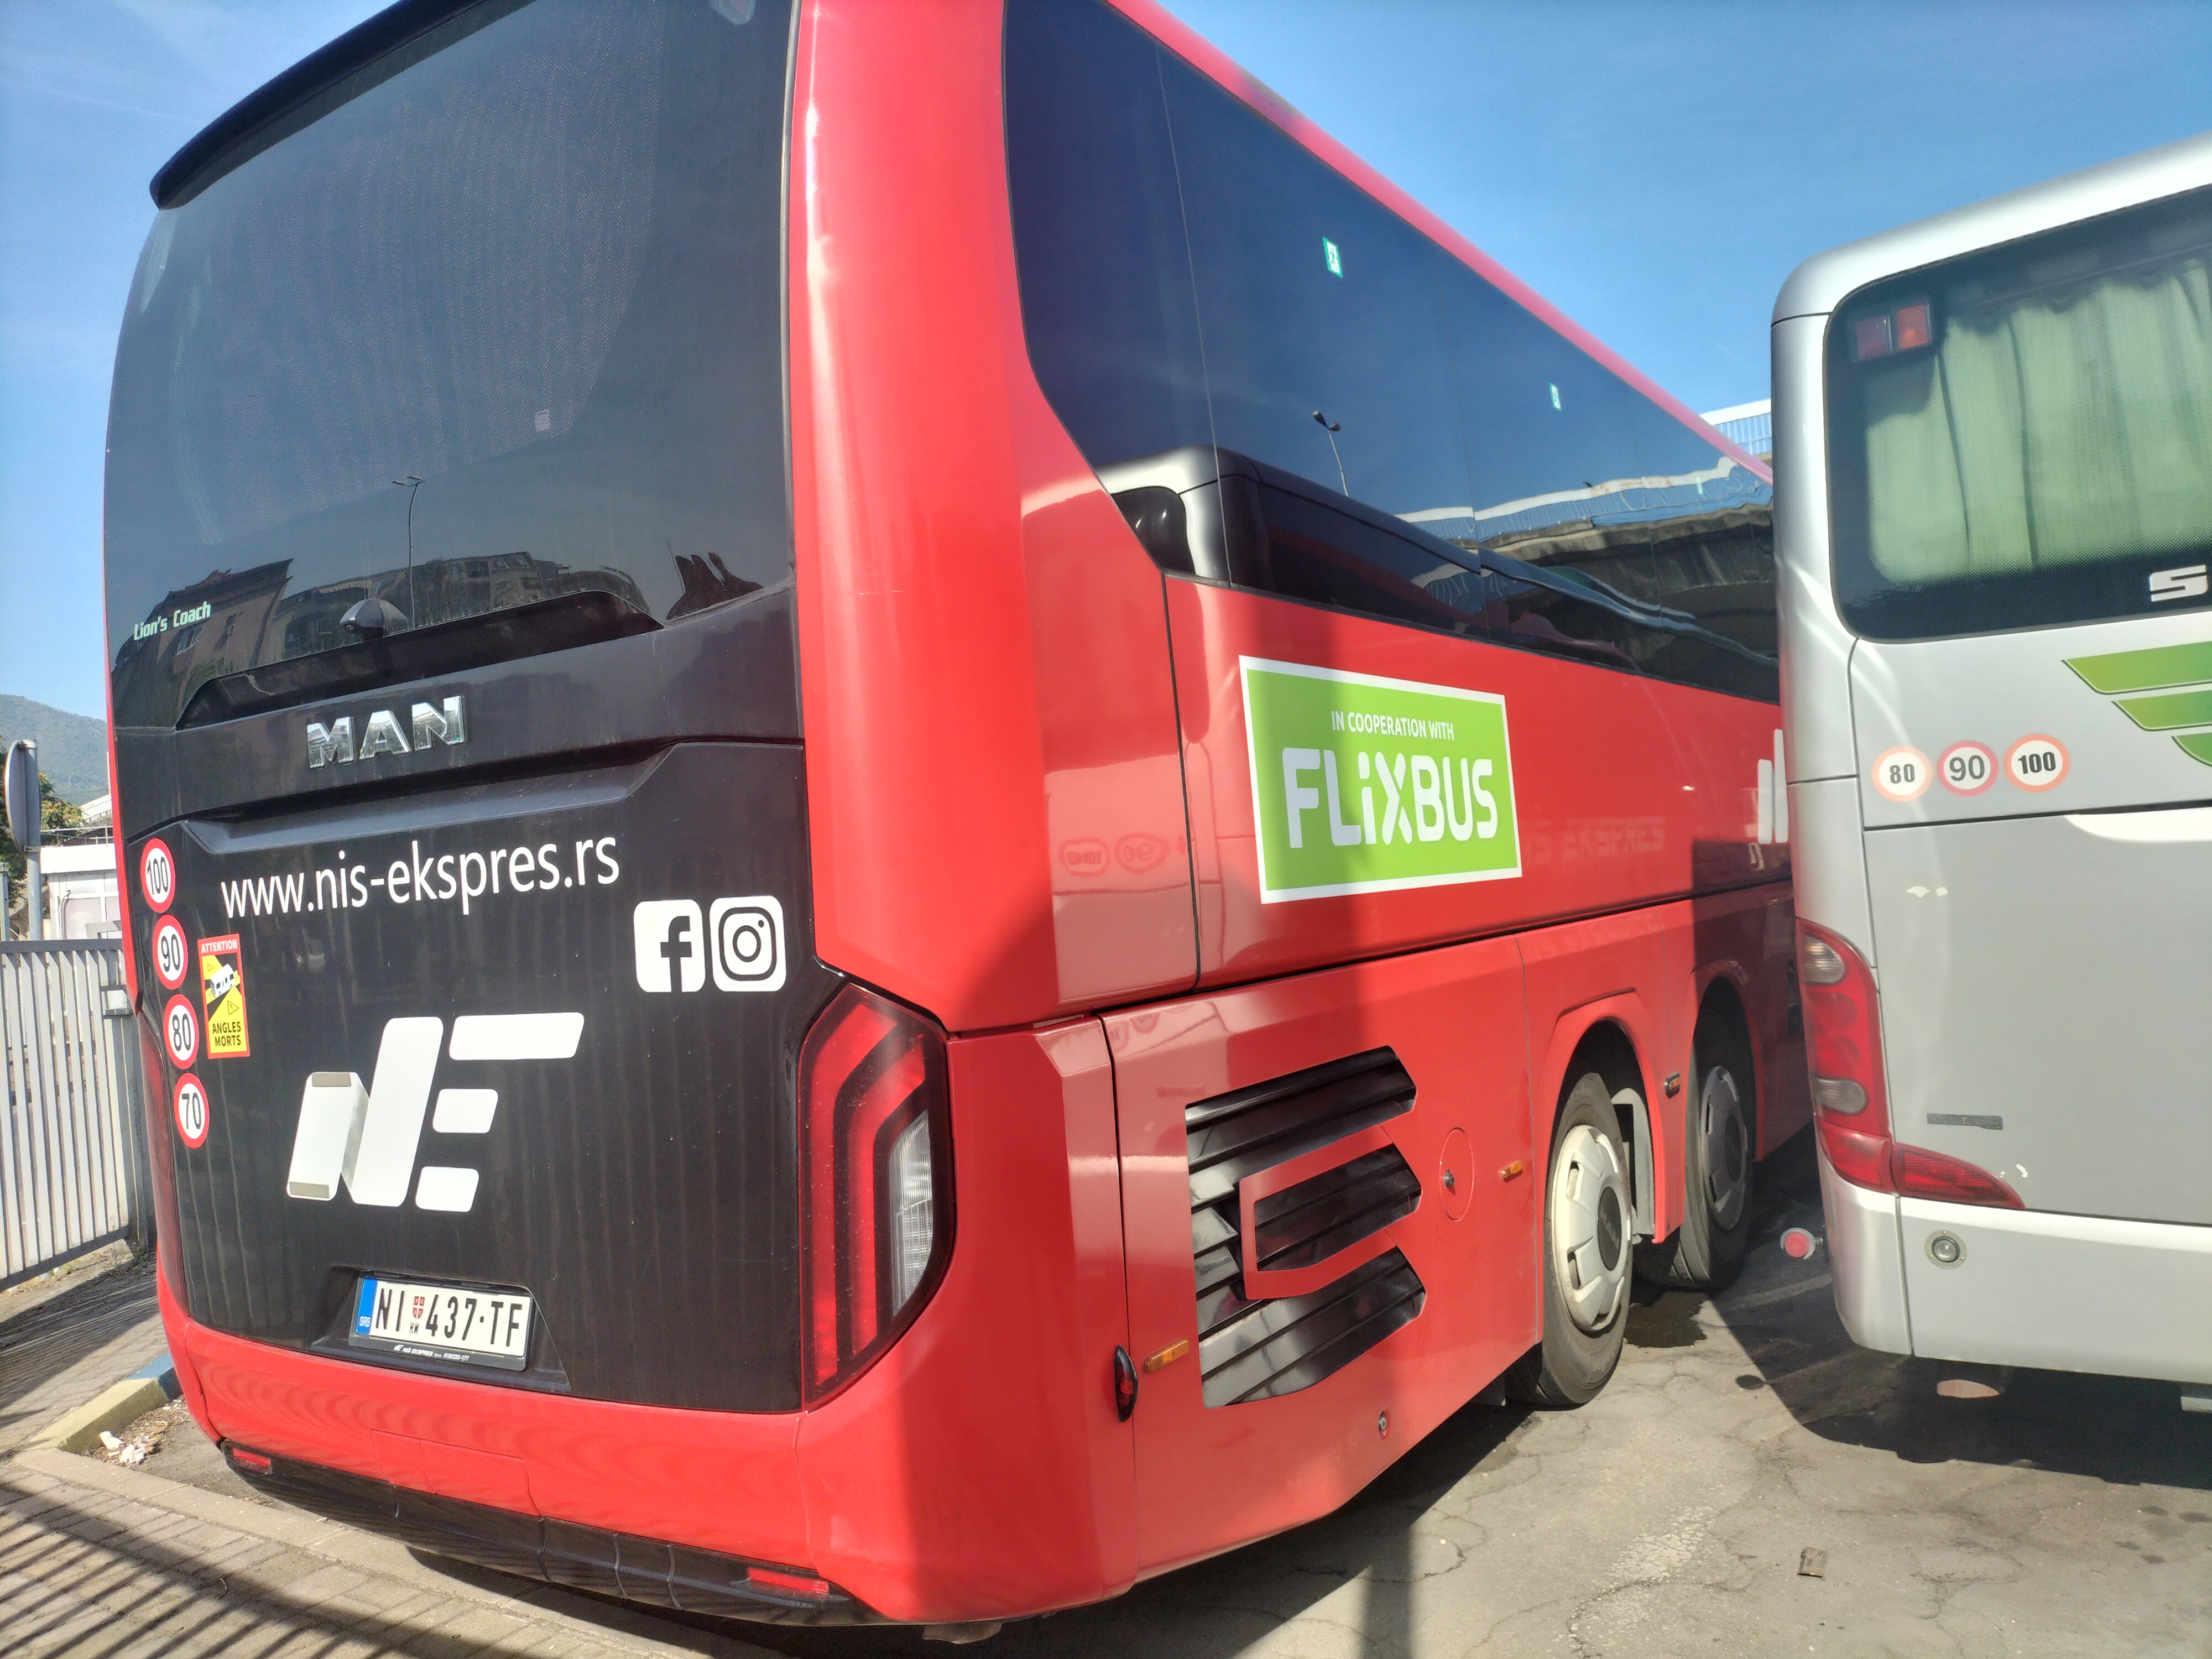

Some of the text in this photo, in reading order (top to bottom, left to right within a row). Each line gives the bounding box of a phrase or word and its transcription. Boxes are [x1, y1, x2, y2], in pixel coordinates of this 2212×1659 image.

[133, 601, 211, 641] Lion's Coach
[306, 695, 467, 769] MAN
[1331, 710, 1454, 740] IN COOPERATION WITH
[1889, 763, 1916, 784] 80
[1949, 754, 1985, 781] 90
[2017, 751, 2057, 775] 100
[145, 855, 169, 896] 100
[221, 837, 619, 919] www.nis-ekspres.rs
[160, 933, 181, 973] 90
[201, 938, 238, 954] ATTENTION
[172, 1013, 191, 1052] 80
[212, 1021, 242, 1034] ANGLES
[214, 1034, 242, 1047] MORTS
[181, 1092, 201, 1130] 70
[359, 1316, 371, 1328] SRB
[375, 1287, 405, 1332] NI
